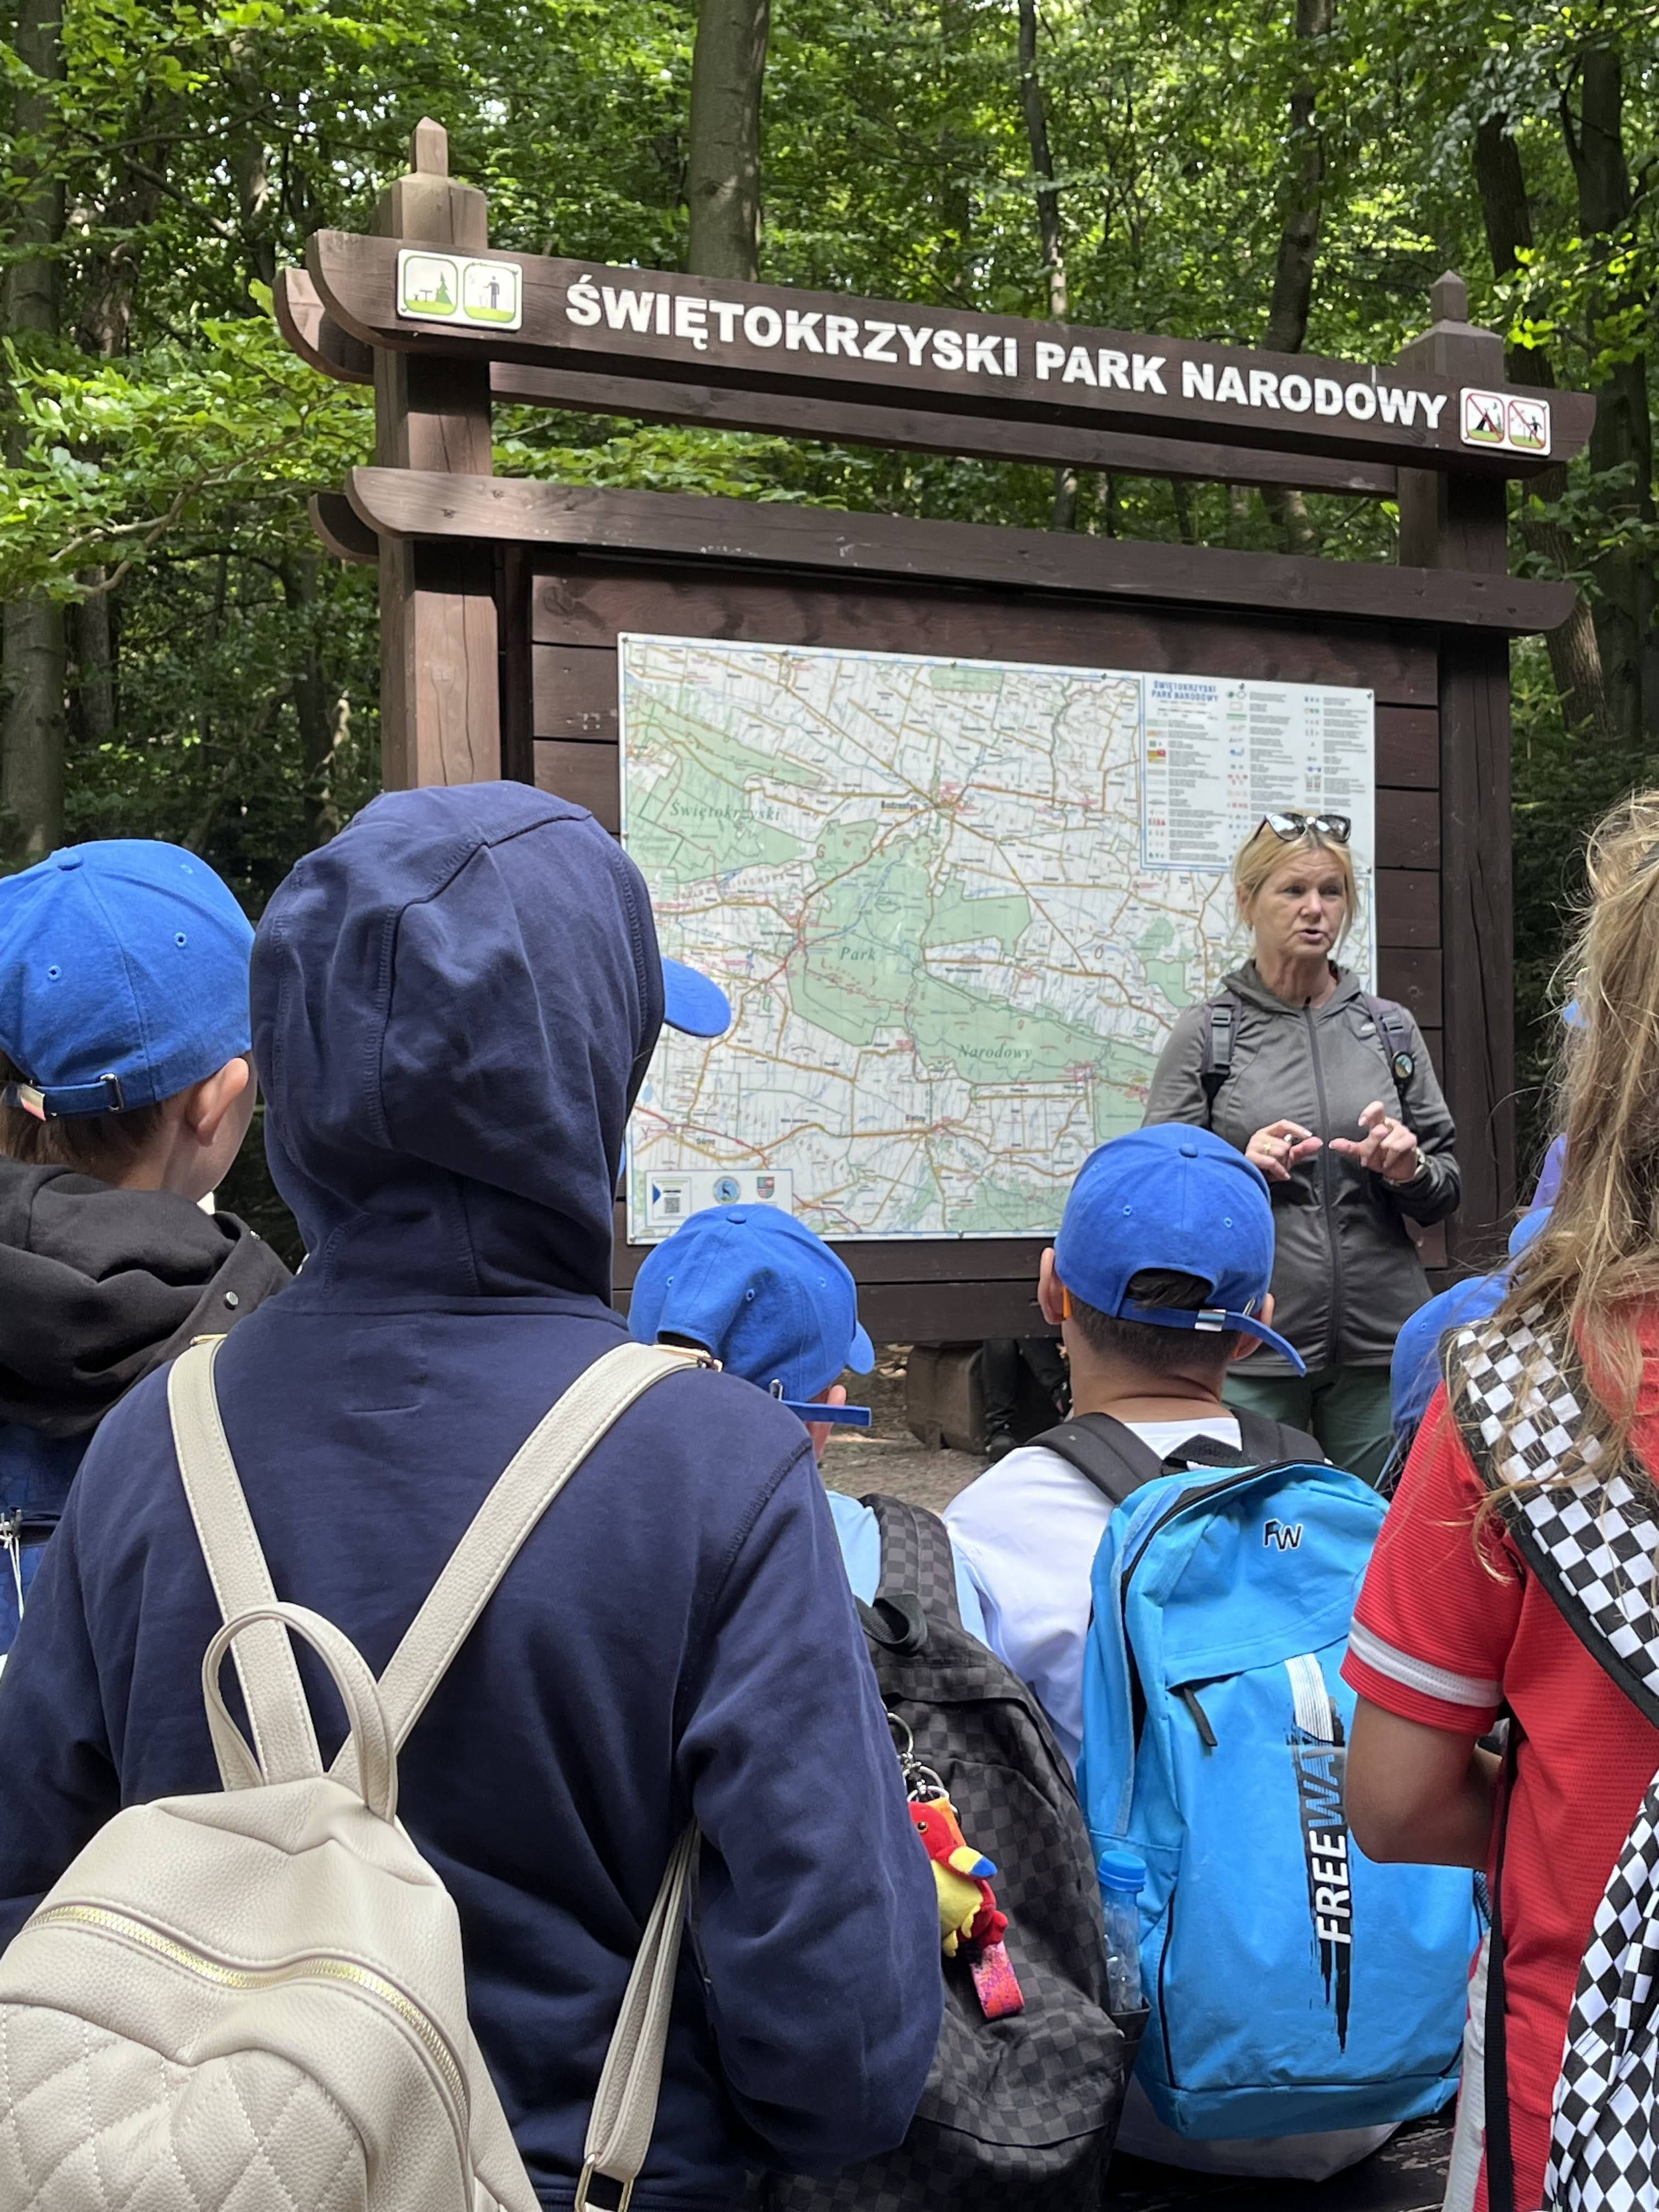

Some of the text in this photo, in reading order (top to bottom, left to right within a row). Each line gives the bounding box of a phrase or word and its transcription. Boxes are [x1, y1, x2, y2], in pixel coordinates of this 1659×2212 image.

[565, 275, 1447, 429] ŚWIĘTOKRZYSKI PARK NARODOWY
[1152, 690, 1218, 702] PARK NARODOWY
[670, 798, 781, 823] Świętokrzyski
[839, 946, 875, 961] Park
[958, 1043, 1032, 1063] Narodowy
[1264, 1519, 1303, 1551] FW
[1302, 1746, 1352, 1944] FREEWA
